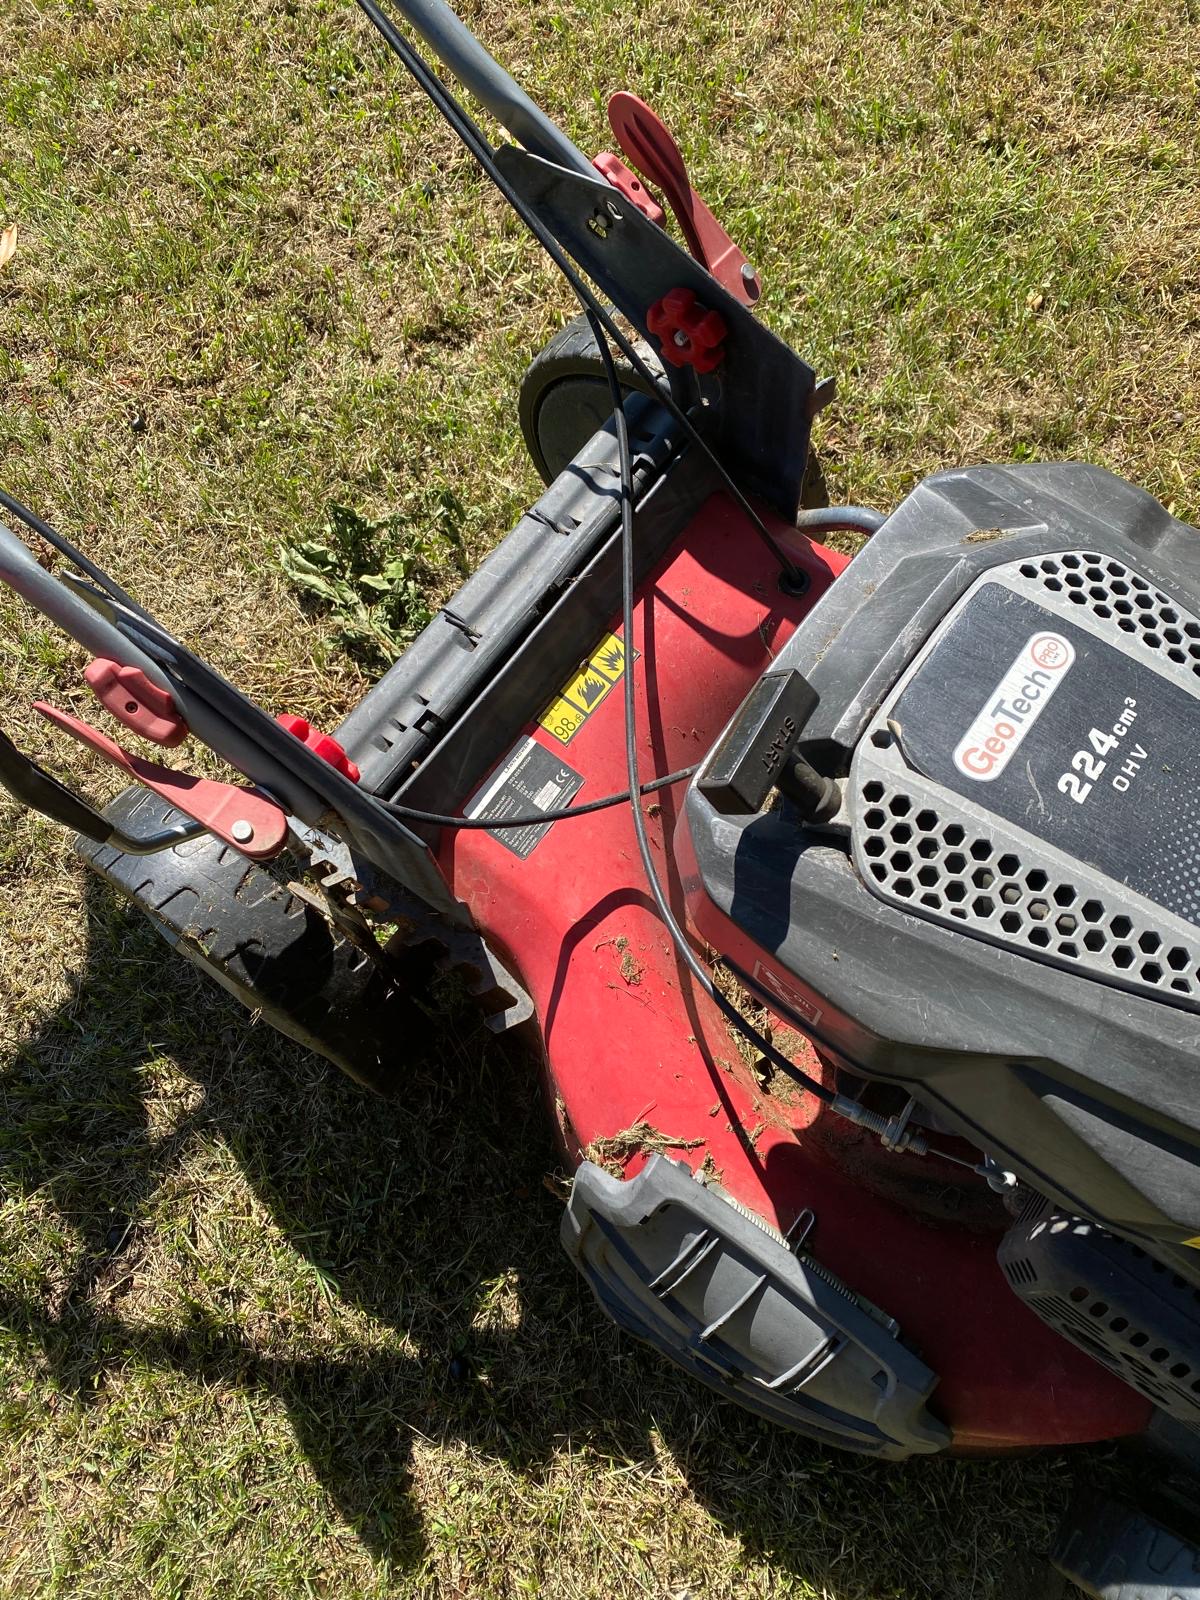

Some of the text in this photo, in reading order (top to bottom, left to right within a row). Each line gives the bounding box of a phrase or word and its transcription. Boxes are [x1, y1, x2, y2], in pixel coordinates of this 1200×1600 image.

[1039, 642, 1058, 664] PRO
[762, 716, 795, 774] START
[962, 670, 1052, 774] GeoTech
[1112, 743, 1148, 792] OHV
